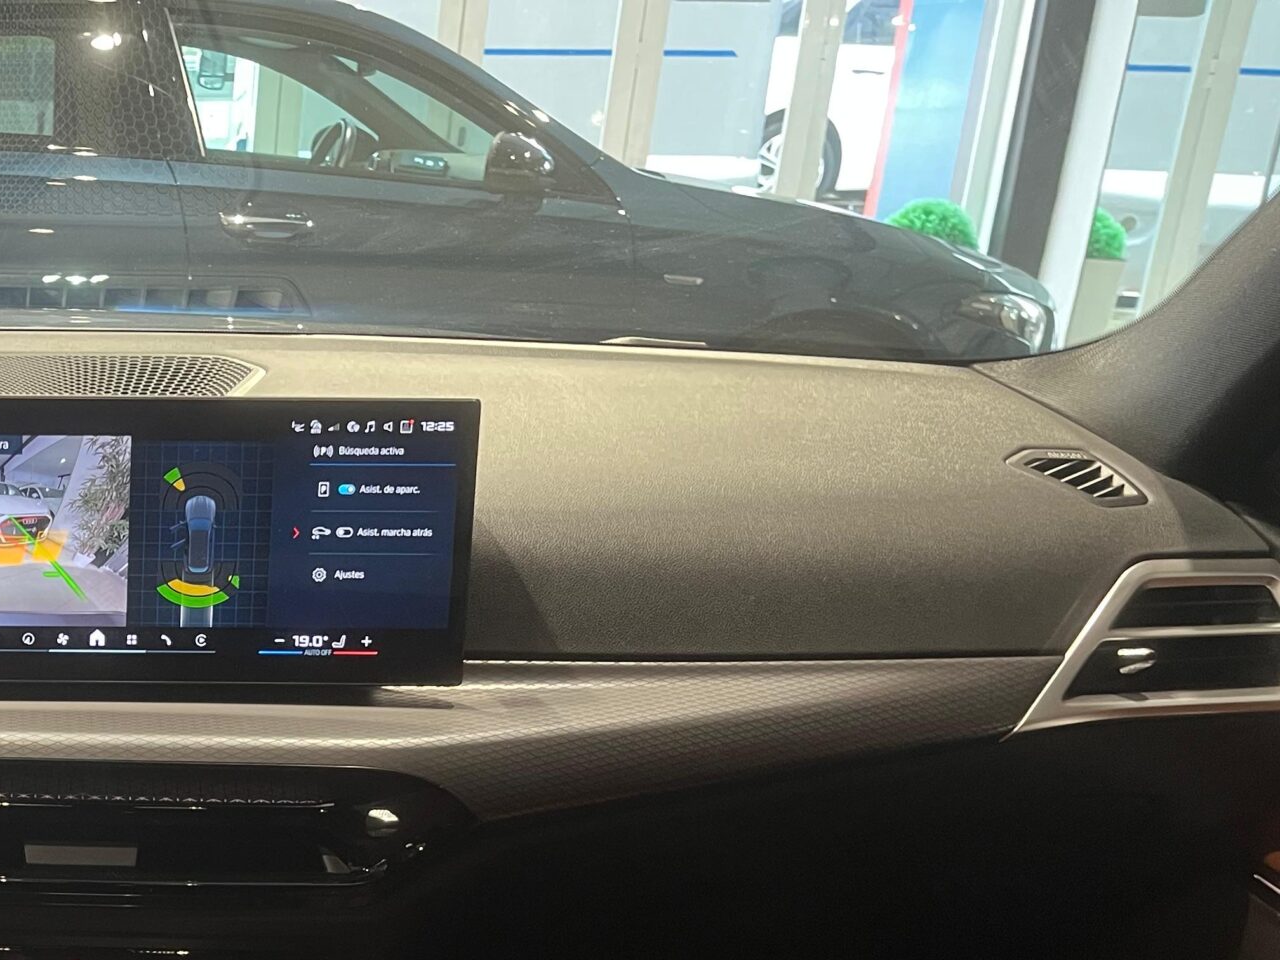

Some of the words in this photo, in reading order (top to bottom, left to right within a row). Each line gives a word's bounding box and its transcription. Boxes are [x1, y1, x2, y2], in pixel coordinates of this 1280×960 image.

[420, 421, 455, 432] 12:25
[338, 445, 379, 457] Búsqueda
[380, 446, 405, 456] activa
[359, 485, 382, 494] Asist.
[384, 485, 395, 494] de
[396, 486, 420, 496] aparc.
[356, 527, 379, 537] Asist.
[381, 528, 410, 537] marcha
[411, 527, 433, 537] atrás
[334, 570, 365, 580] Ajustes
